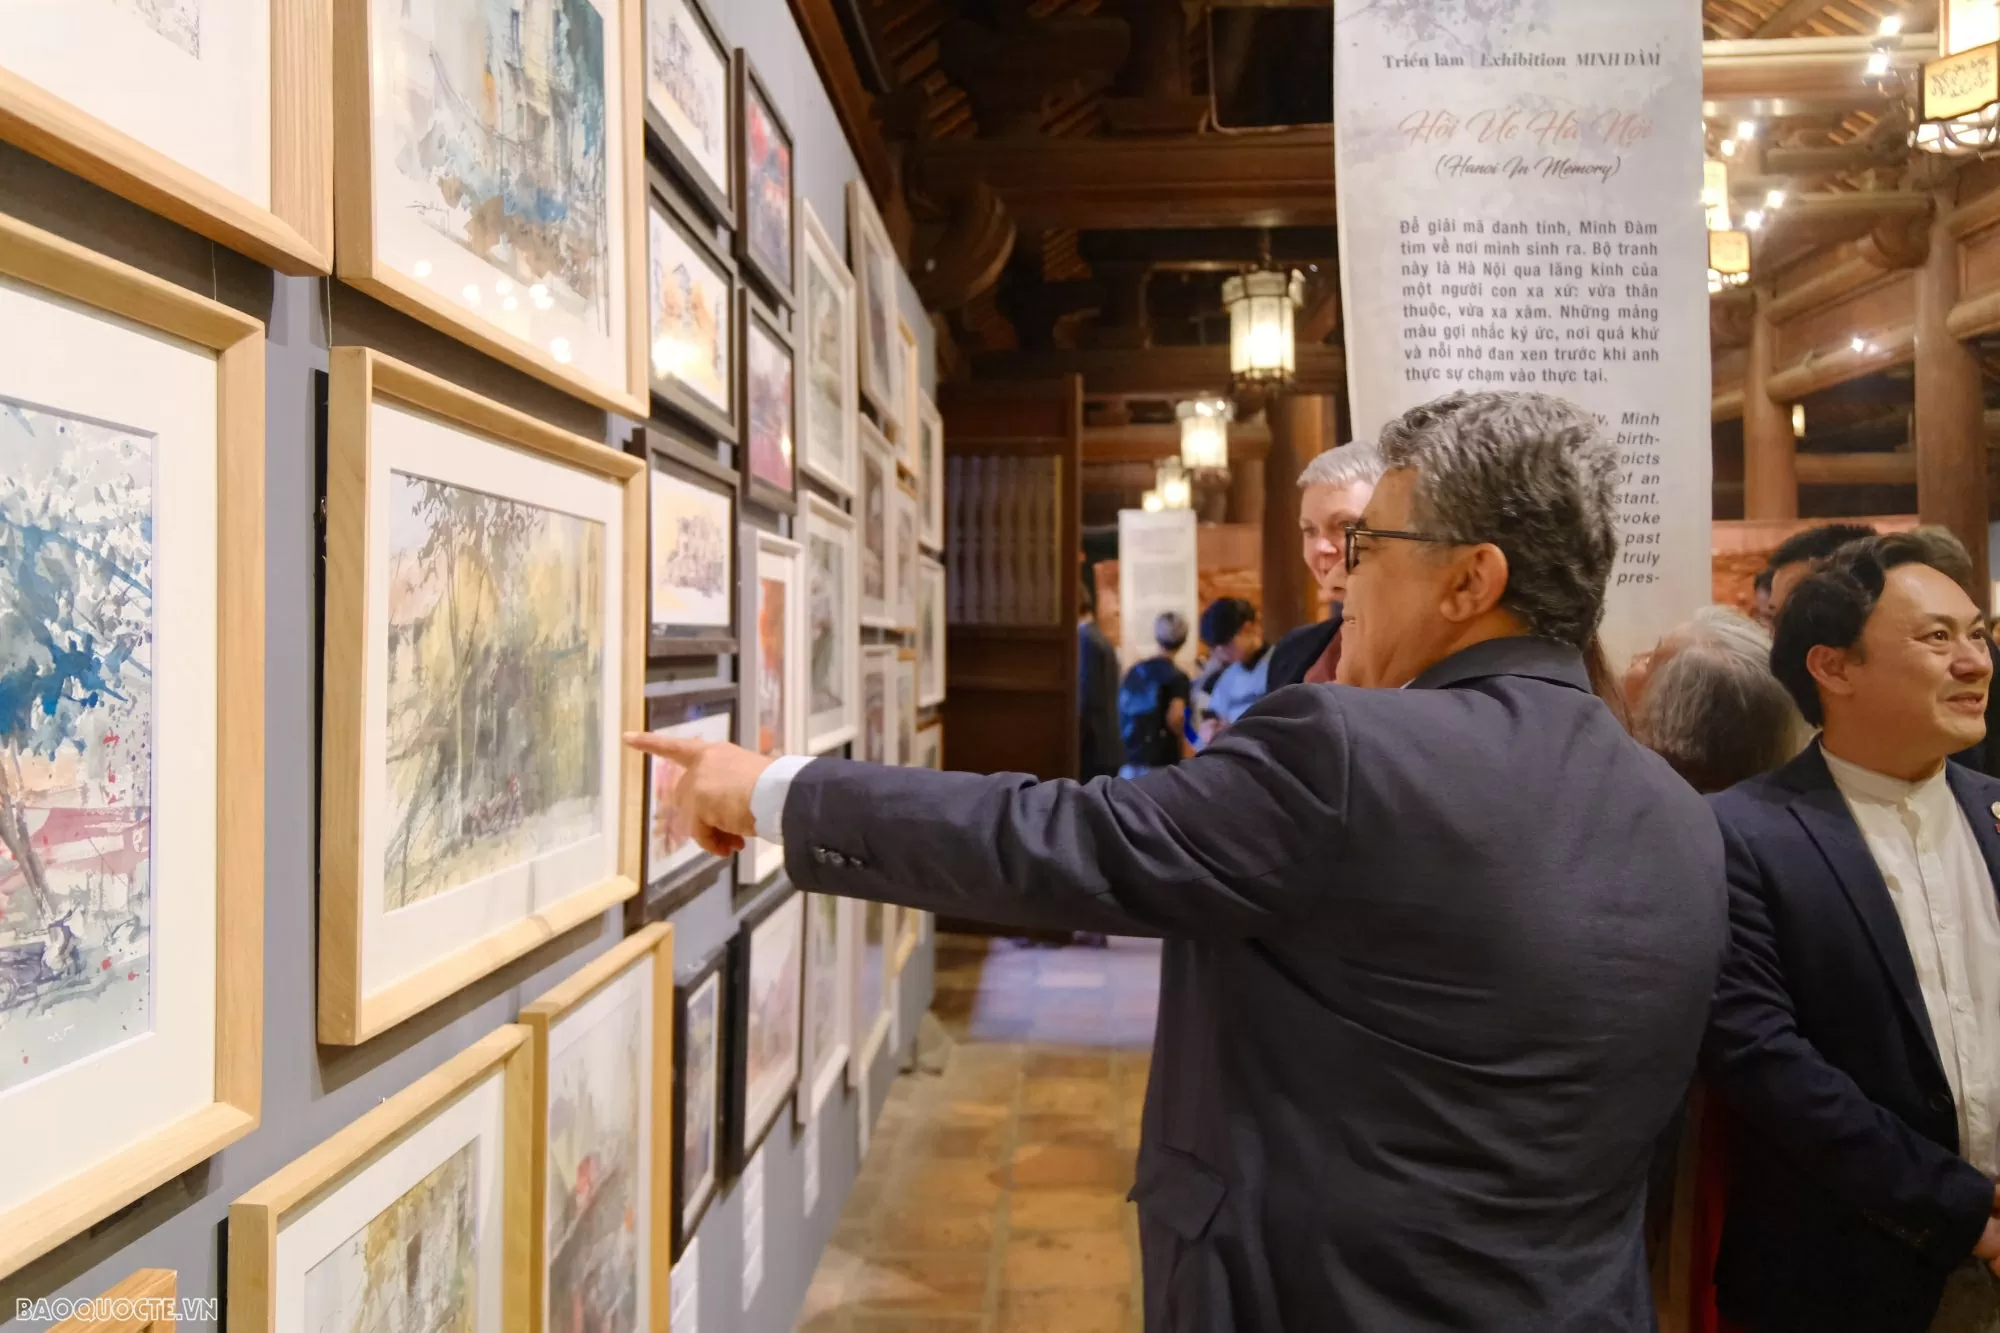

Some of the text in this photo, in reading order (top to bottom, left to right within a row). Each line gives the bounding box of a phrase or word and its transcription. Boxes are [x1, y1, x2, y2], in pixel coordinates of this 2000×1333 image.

[1479, 51, 1567, 68] Exhibition
[1575, 53, 1620, 67] MINH
[1502, 156, 1529, 175] In
[1491, 220, 1528, 235] danh
[1579, 219, 1617, 235] Minh
[1526, 241, 1560, 256] sinh
[1565, 243, 1586, 256] ra.
[1617, 241, 1658, 257] tranh
[1513, 265, 1541, 280] qua
[1491, 286, 1517, 298] con
[1526, 286, 1545, 299] xa
[1491, 307, 1508, 319] xa
[1520, 349, 1548, 362] xen
[1602, 346, 1627, 361] khi
[1632, 347, 1660, 362] anh
[1621, 412, 1660, 426] Minh
[1616, 431, 1661, 446] birth-
[1620, 452, 1660, 465] picts
[1640, 474, 1660, 485] an
[1613, 492, 1660, 505] stant.
[1625, 533, 1661, 546] past
[1623, 551, 1661, 567] truly
[1616, 573, 1661, 587] pres-
